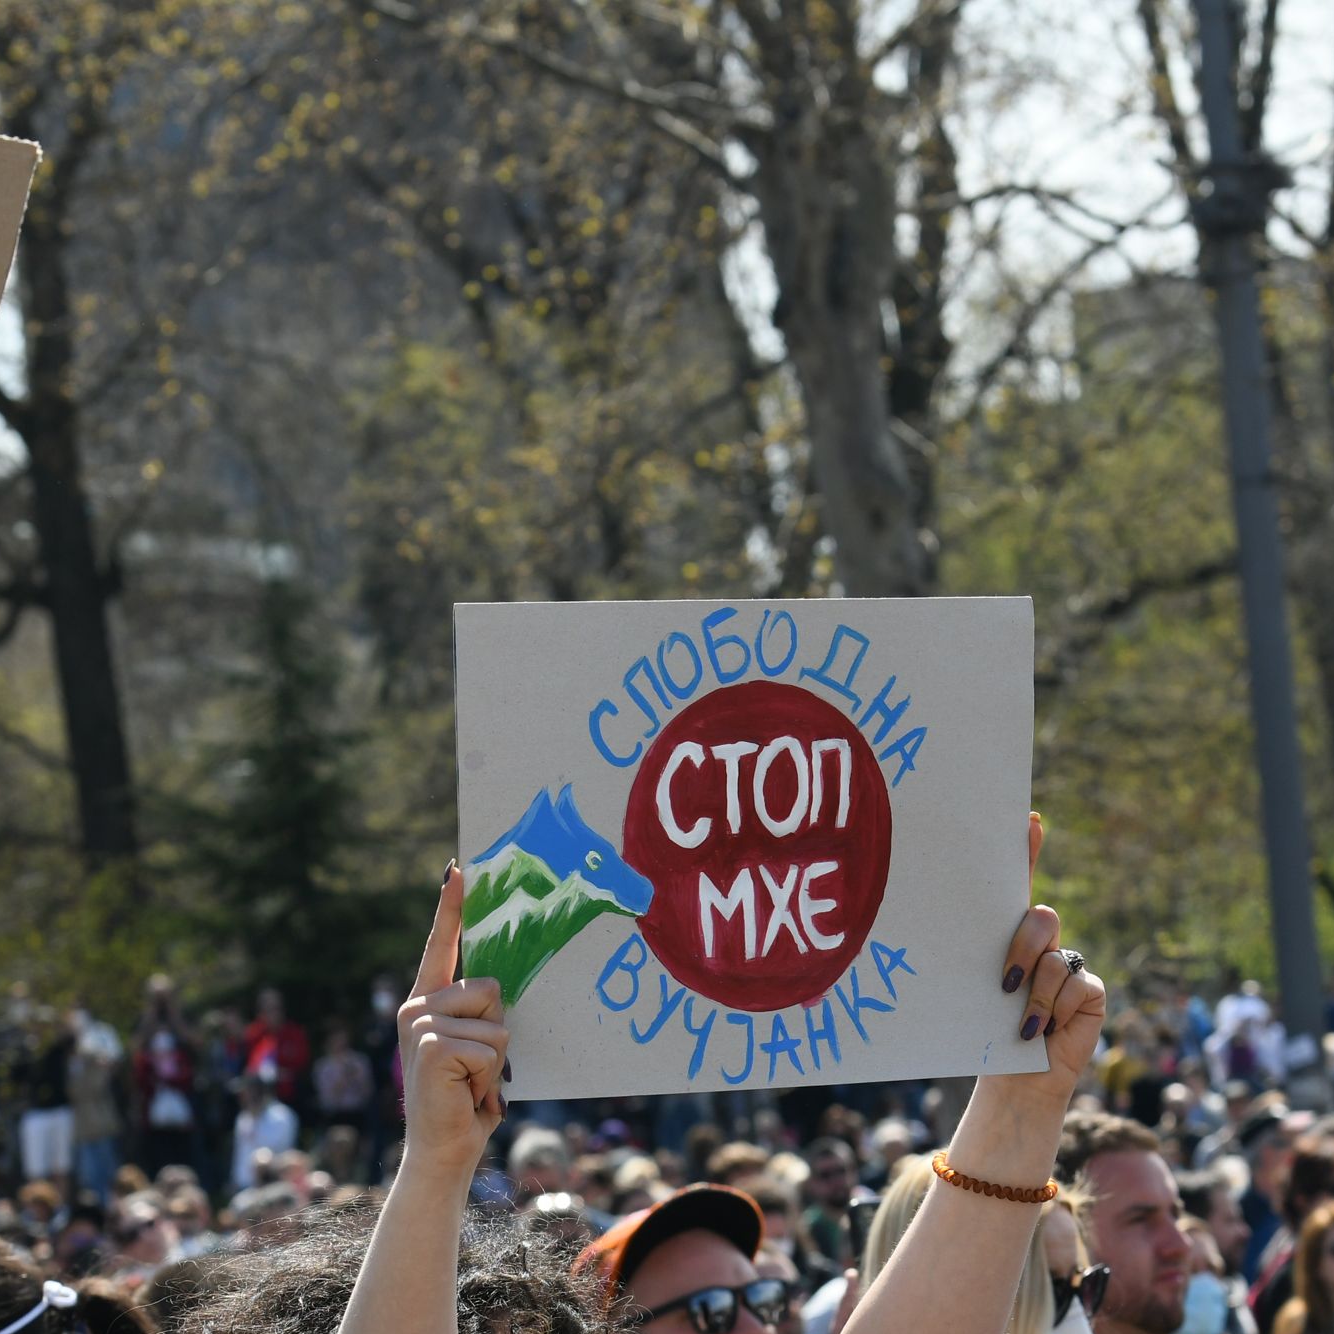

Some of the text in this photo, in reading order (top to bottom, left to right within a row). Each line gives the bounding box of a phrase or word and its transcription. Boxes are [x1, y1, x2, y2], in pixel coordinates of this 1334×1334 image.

[588, 606, 928, 788] СЛОБОДНА
[655, 735, 852, 850] СТОП
[698, 860, 845, 960] МХЕ
[595, 932, 917, 1085] ВУЧЈАНКА
